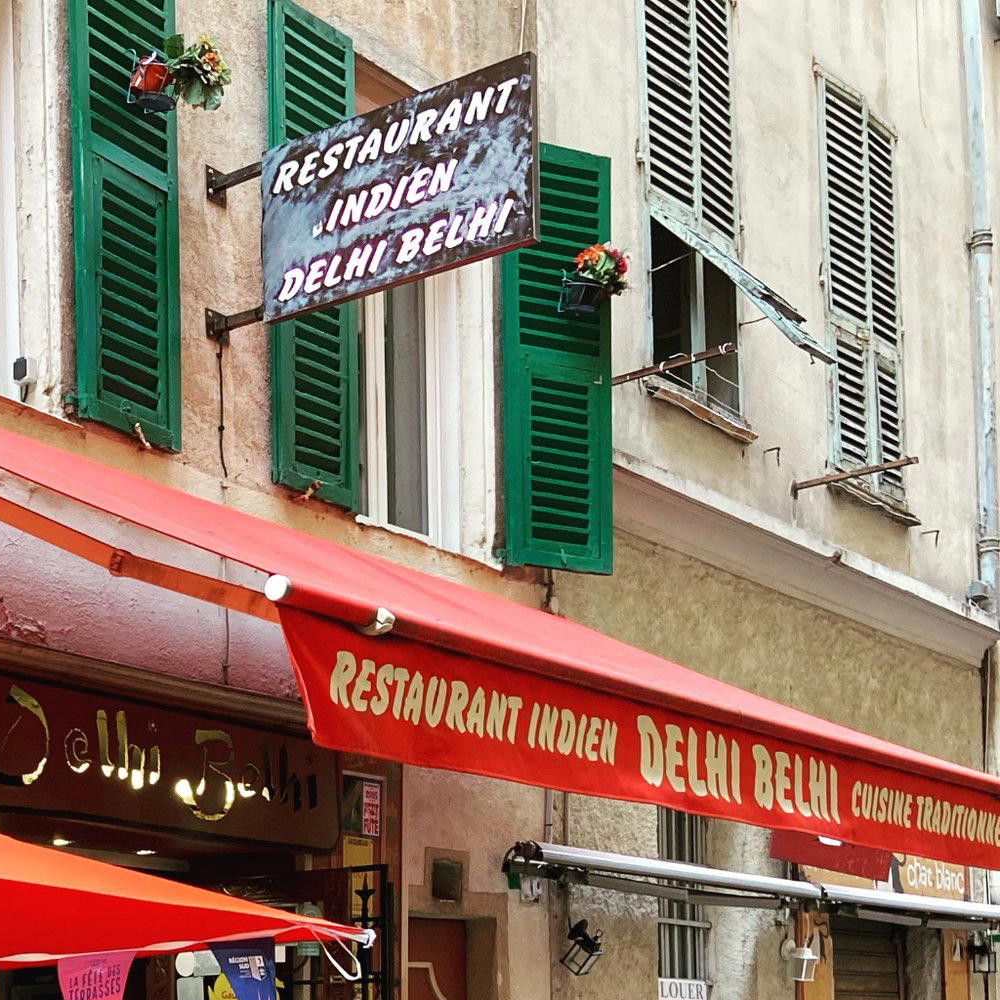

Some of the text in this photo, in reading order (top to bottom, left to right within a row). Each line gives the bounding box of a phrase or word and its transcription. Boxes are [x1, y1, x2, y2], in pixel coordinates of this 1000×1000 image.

[272, 77, 519, 194] RESTAURANT
[324, 158, 459, 232] INDIEN
[277, 198, 515, 302] DELHI BELHI
[174, 729, 318, 822] Belhi
[329, 650, 523, 745] RESTAURANT
[527, 702, 618, 766] INDIEN
[636, 714, 743, 805] DELHI
[752, 743, 842, 825] BELHI
[851, 780, 914, 829] CUISINE
[906, 856, 965, 894] chat blanc
[69, 976, 79, 988] LA
[107, 964, 121, 978] DES
[660, 981, 704, 1000] LOUER
